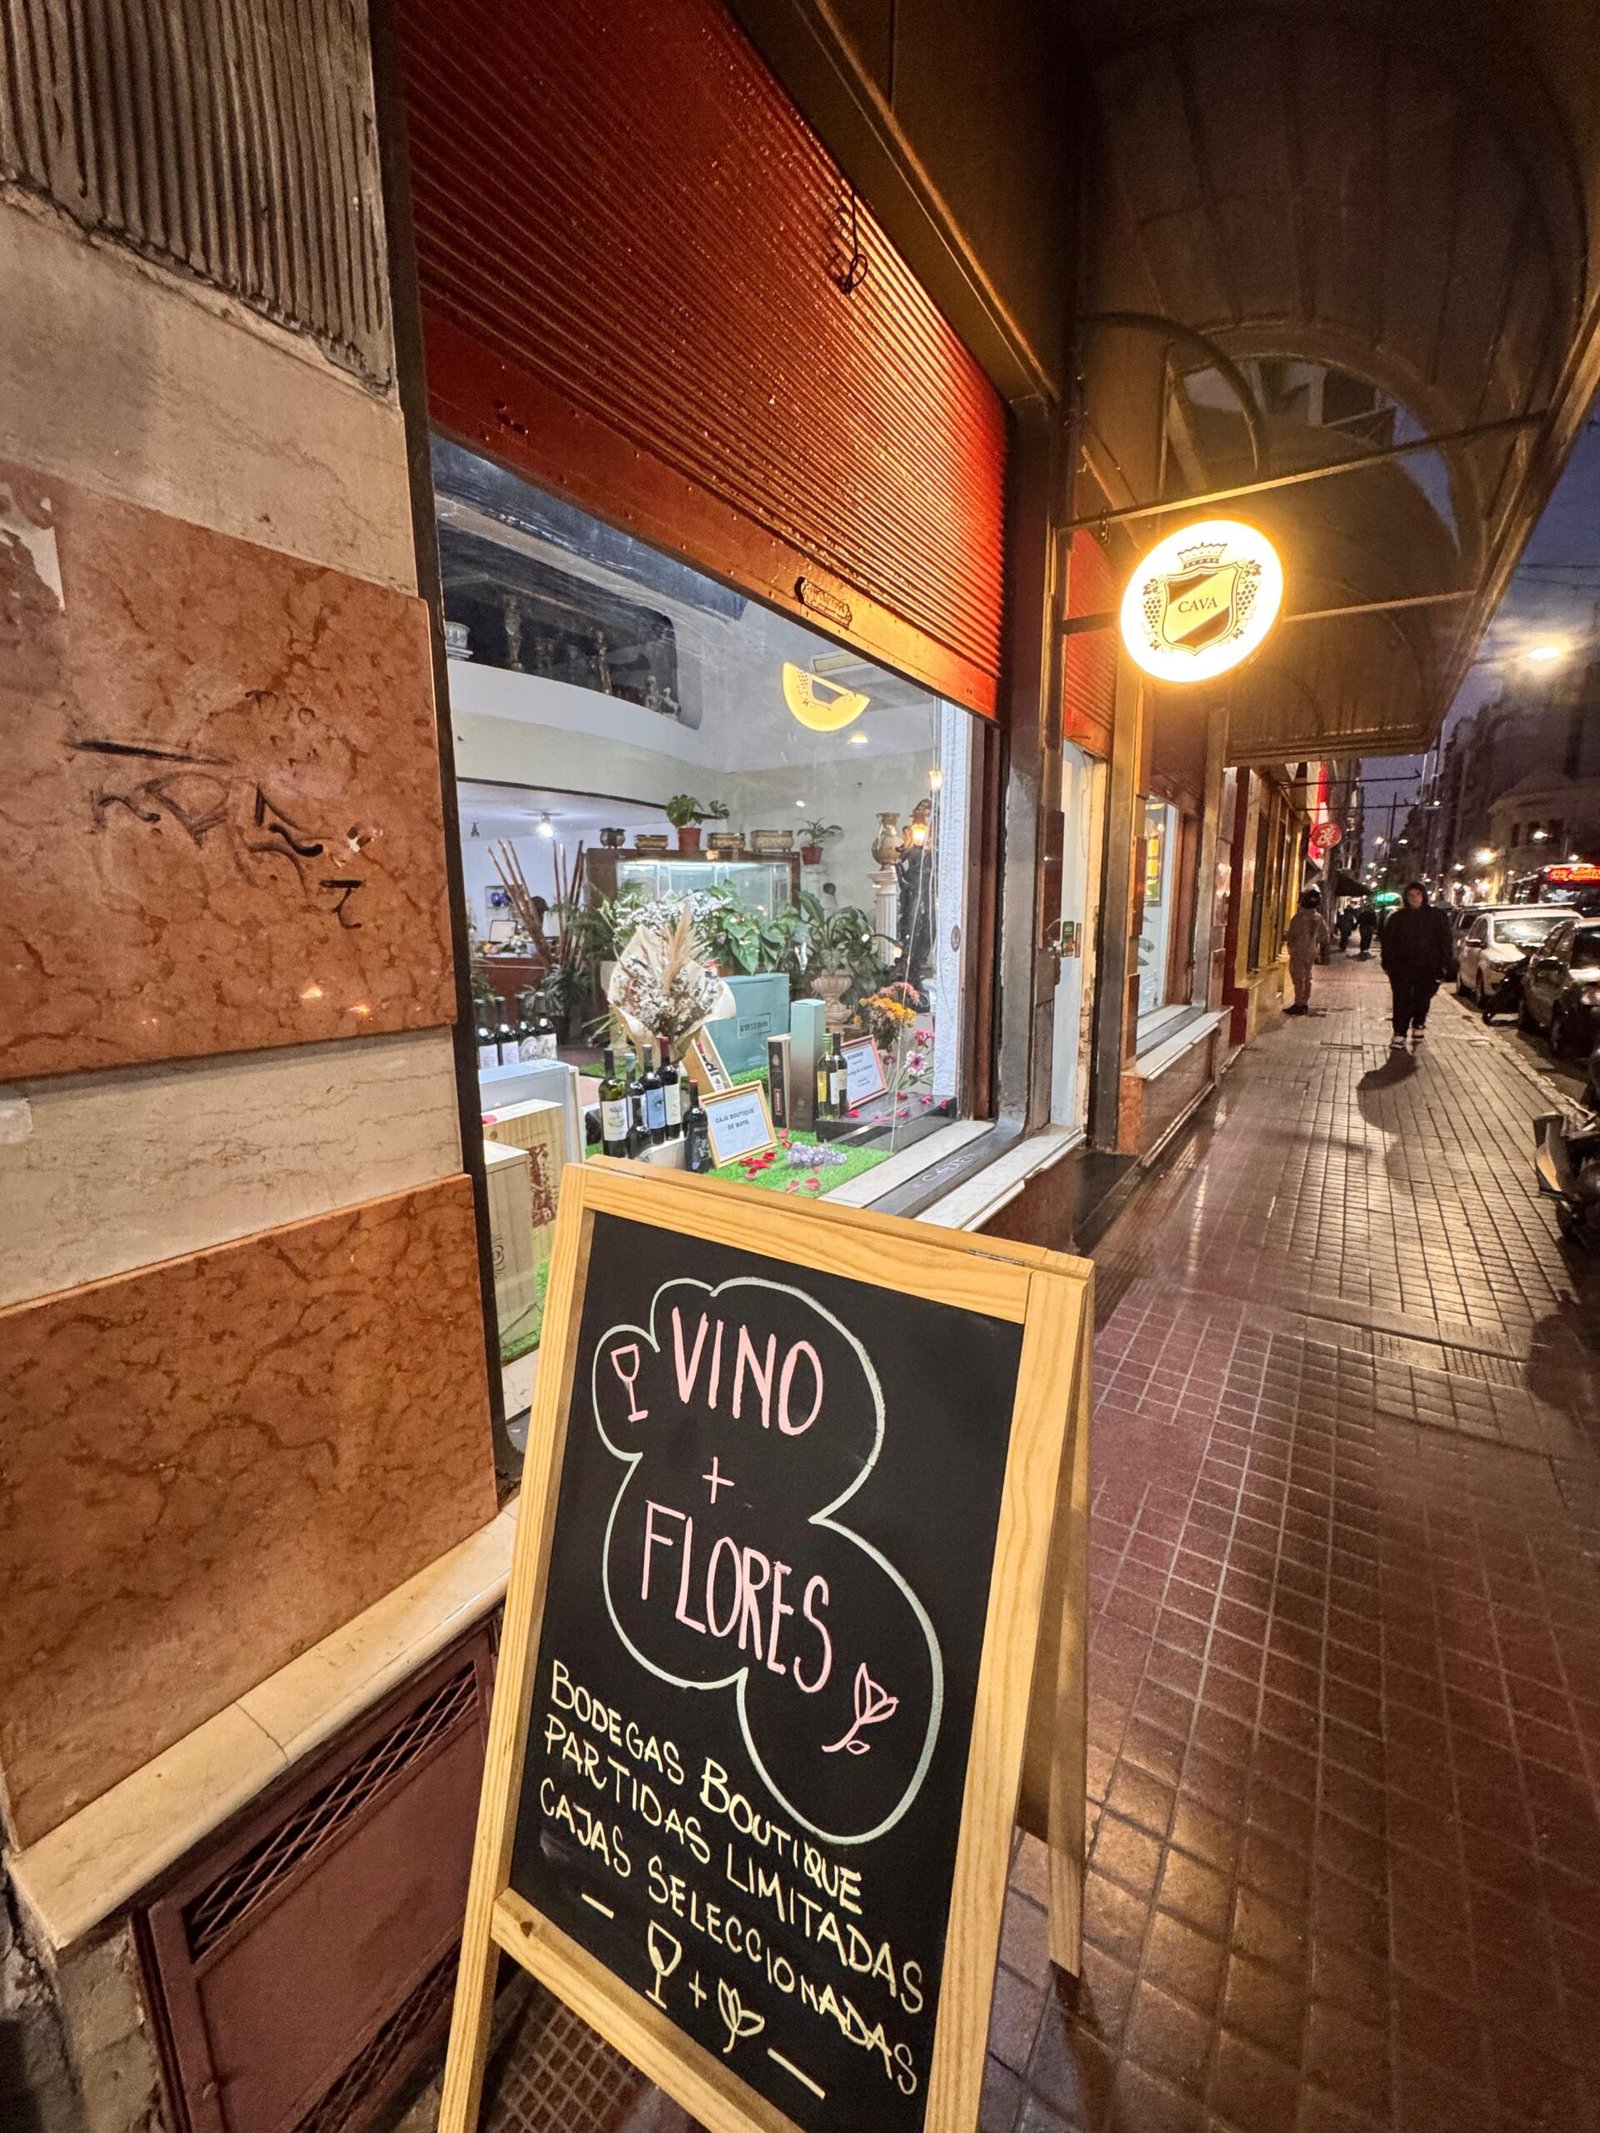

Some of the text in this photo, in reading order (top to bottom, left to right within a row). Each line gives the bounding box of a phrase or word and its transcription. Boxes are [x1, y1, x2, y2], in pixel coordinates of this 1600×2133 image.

[1178, 597, 1217, 613] CAVA
[715, 1114, 729, 1124] CAJA
[672, 1307, 823, 1436] VINO
[642, 1500, 832, 1693] FLORES
[545, 1714, 923, 2013] PARTIDAS LIMITADAS
[551, 1660, 862, 1914] BODEGAS BOUTIQUE
[541, 1778, 916, 2094] CAJAS SELECCIONADAS
